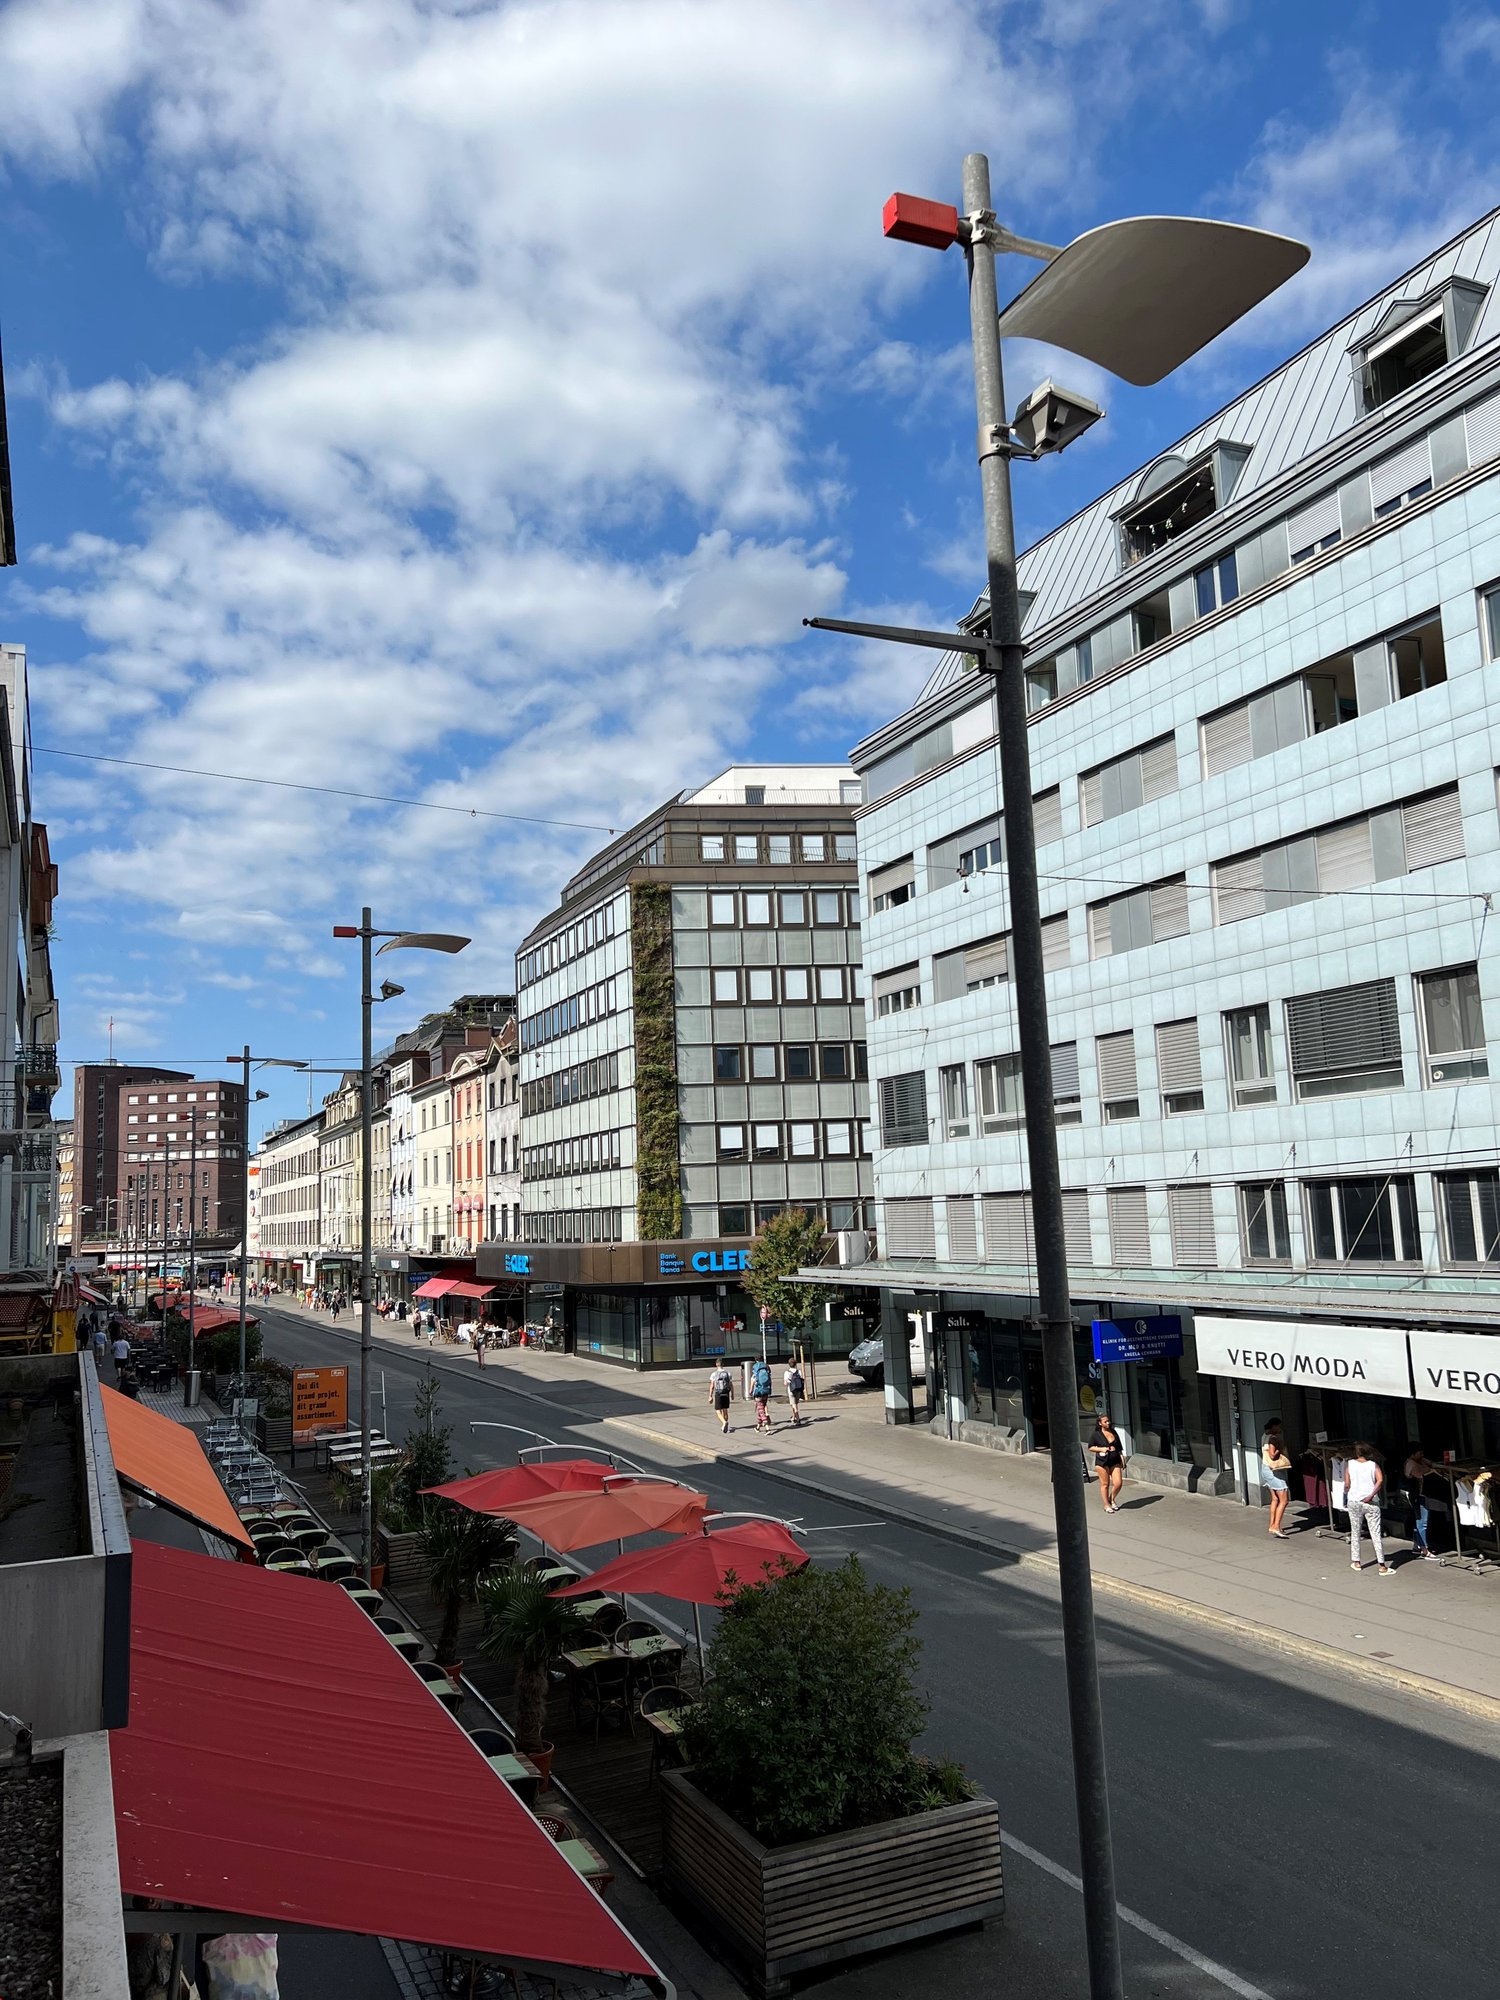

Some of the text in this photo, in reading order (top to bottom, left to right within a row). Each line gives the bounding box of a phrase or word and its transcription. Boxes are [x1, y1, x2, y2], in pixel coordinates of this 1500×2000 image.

[511, 1254, 529, 1273] CLER
[660, 1260, 685, 1268] Banque
[691, 1250, 752, 1272] CLER
[844, 1306, 864, 1317] Salt.
[948, 1316, 970, 1328] Salt.
[1227, 1348, 1366, 1380] VERO MODA
[296, 1382, 308, 1391] Qui
[1426, 1368, 1500, 1394] VERO
[297, 1392, 315, 1401] grand
[309, 1401, 327, 1410] grand
